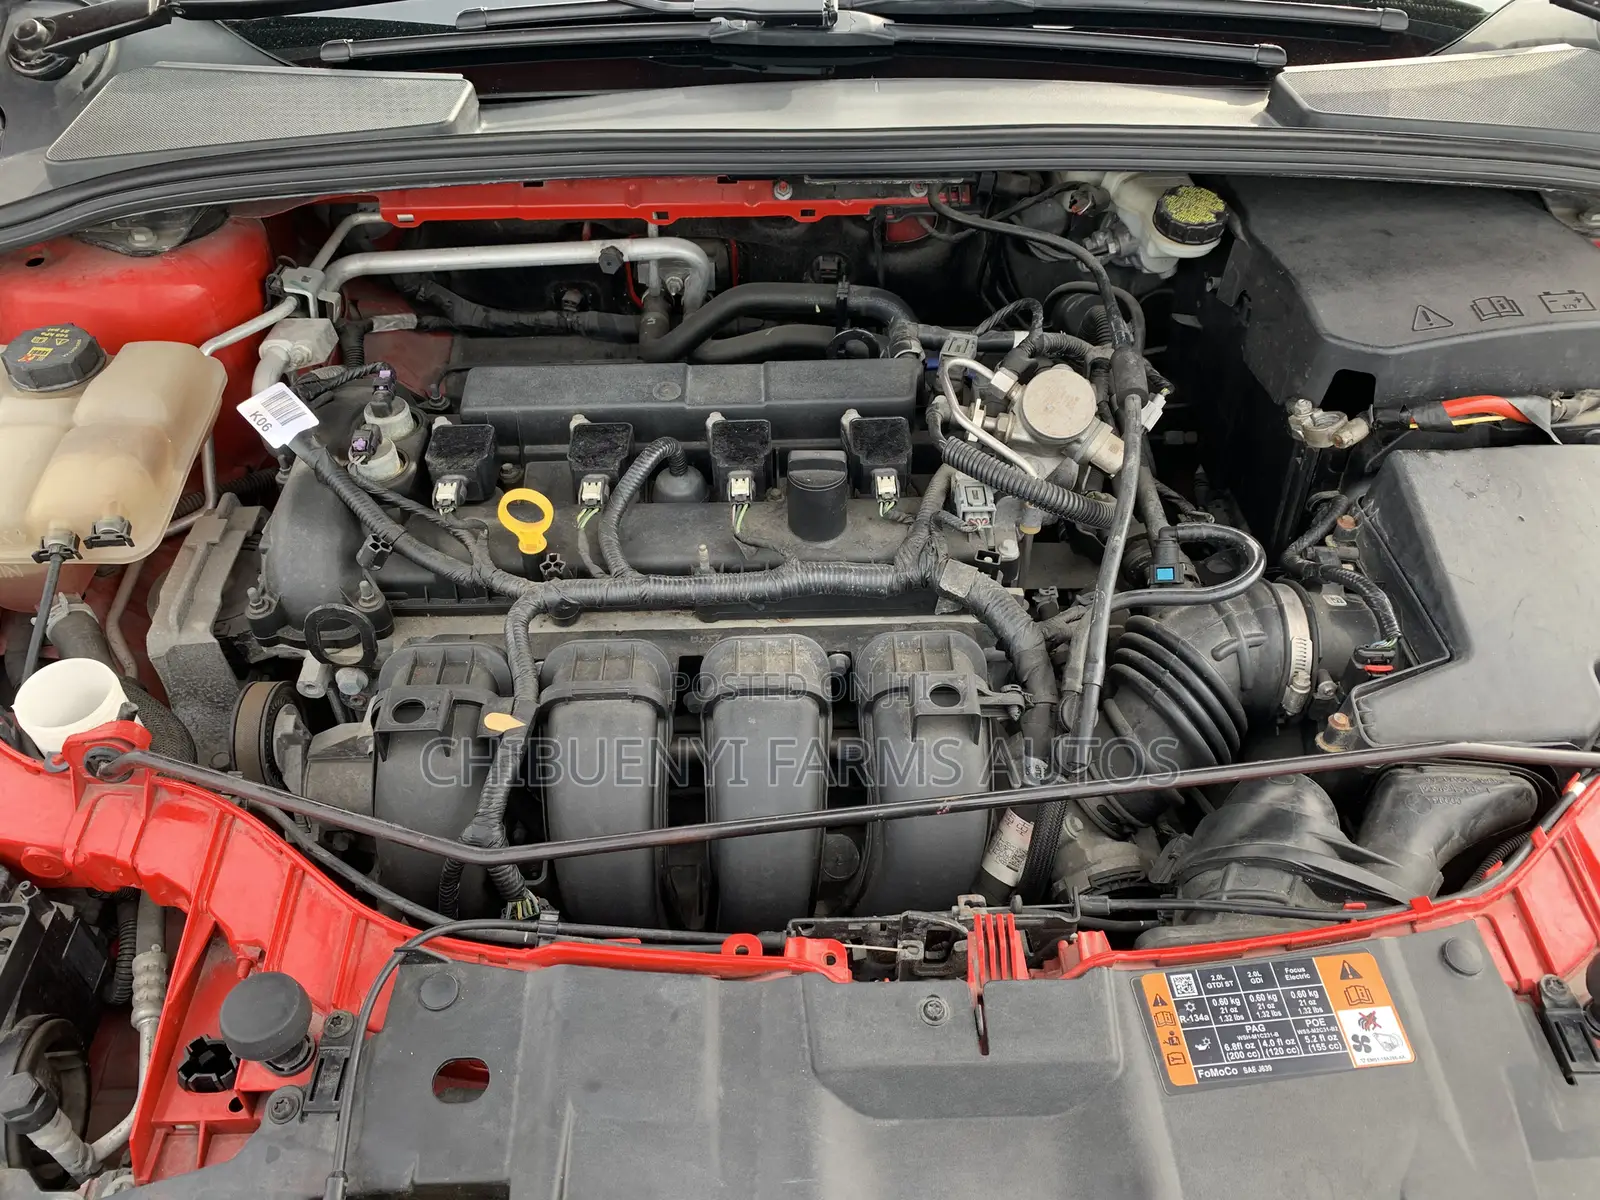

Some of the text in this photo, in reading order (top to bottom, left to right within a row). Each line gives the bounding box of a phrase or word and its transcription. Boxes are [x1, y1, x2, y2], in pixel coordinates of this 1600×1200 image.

[249, 410, 273, 432] K06
[1210, 974, 1226, 982] 2.0L
[1246, 970, 1262, 978] 2.0L
[1284, 973, 1311, 981] Electric
[1206, 980, 1234, 989] GTDI ST
[1250, 977, 1264, 985] GDI
[1249, 992, 1278, 1003] 0.60 kg
[1290, 989, 1319, 999] 0.60 kg
[1212, 996, 1241, 1007] 0.60 kg
[1256, 1009, 1282, 1019] 1.32 lbs
[1298, 1006, 1324, 1015] 1.32 lbs
[1179, 1014, 1210, 1024] R-134a
[1219, 1015, 1233, 1023] 1.32
[1304, 1017, 1327, 1028] POE
[1245, 1023, 1266, 1034] PAG
[1262, 1038, 1297, 1048] 4.0 fl oz
[1304, 1035, 1317, 1044] 5.2
[1319, 1033, 1327, 1042] fl
[1244, 1041, 1256, 1050] oz
[1308, 1041, 1343, 1054] (155 cc)
[1226, 1049, 1261, 1062] (200 cc)
[1265, 1045, 1300, 1058] (120 cc)
[1197, 1066, 1239, 1079] FoMoCo
[1242, 1064, 1273, 1074] SAE J639
